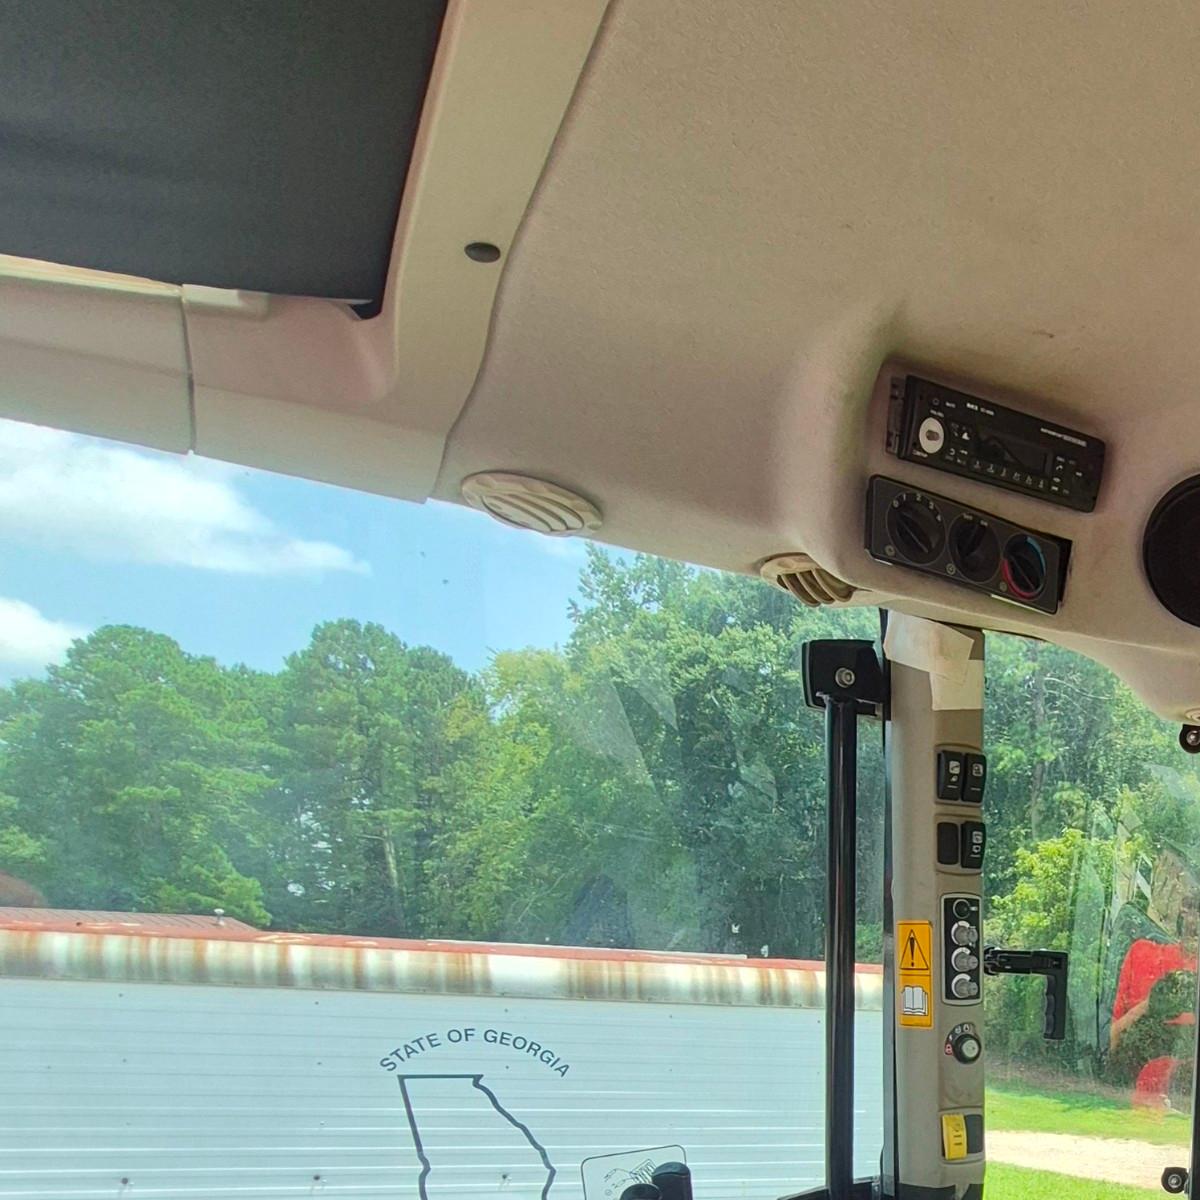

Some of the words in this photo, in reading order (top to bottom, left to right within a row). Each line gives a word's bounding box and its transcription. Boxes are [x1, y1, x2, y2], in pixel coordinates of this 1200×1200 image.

[379, 1032, 442, 1072] STATE
[447, 1027, 476, 1043] OF
[483, 1028, 570, 1078] GEORGIA
